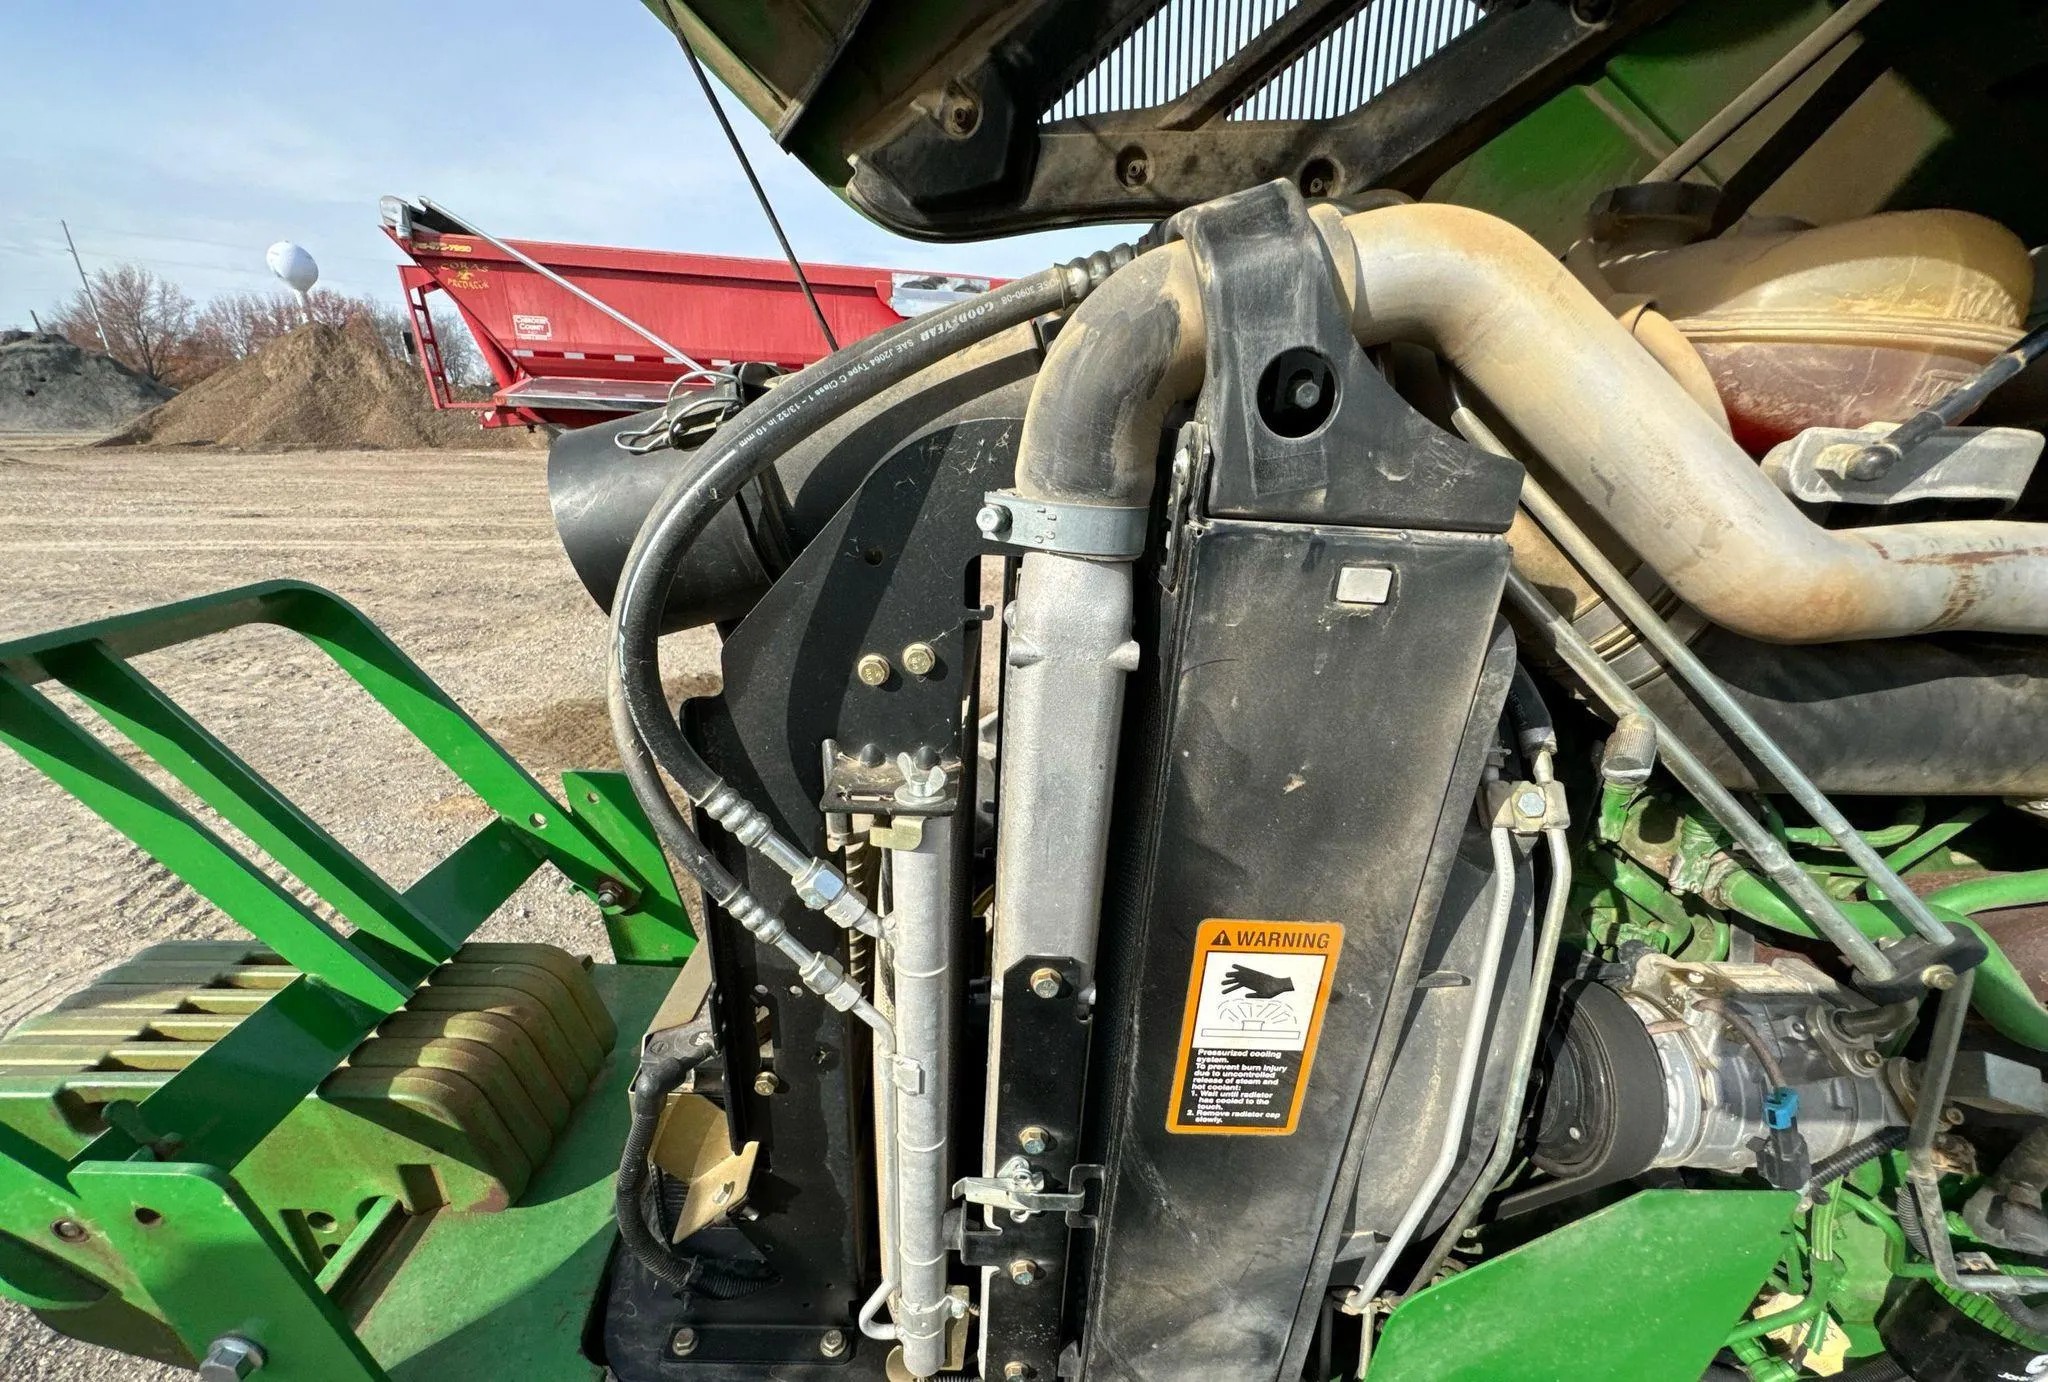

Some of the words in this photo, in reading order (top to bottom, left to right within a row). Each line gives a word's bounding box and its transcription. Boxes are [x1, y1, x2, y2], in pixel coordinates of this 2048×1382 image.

[1000, 285, 1036, 304] 3090-08
[919, 301, 994, 342] GOODYEAR
[896, 338, 914, 354] SAE
[869, 349, 893, 367] J2064
[847, 363, 869, 377] Type
[838, 375, 848, 384] C
[814, 380, 838, 396] Class
[777, 402, 801, 421] 13/32
[767, 418, 778, 426] in
[755, 426, 767, 436] 10
[738, 433, 755, 447] mm
[1237, 930, 1331, 949] WARNING
[1198, 1049, 1249, 1057] Pressurized
[1249, 1051, 1282, 1059] cooling
[1263, 1065, 1288, 1073] injury
